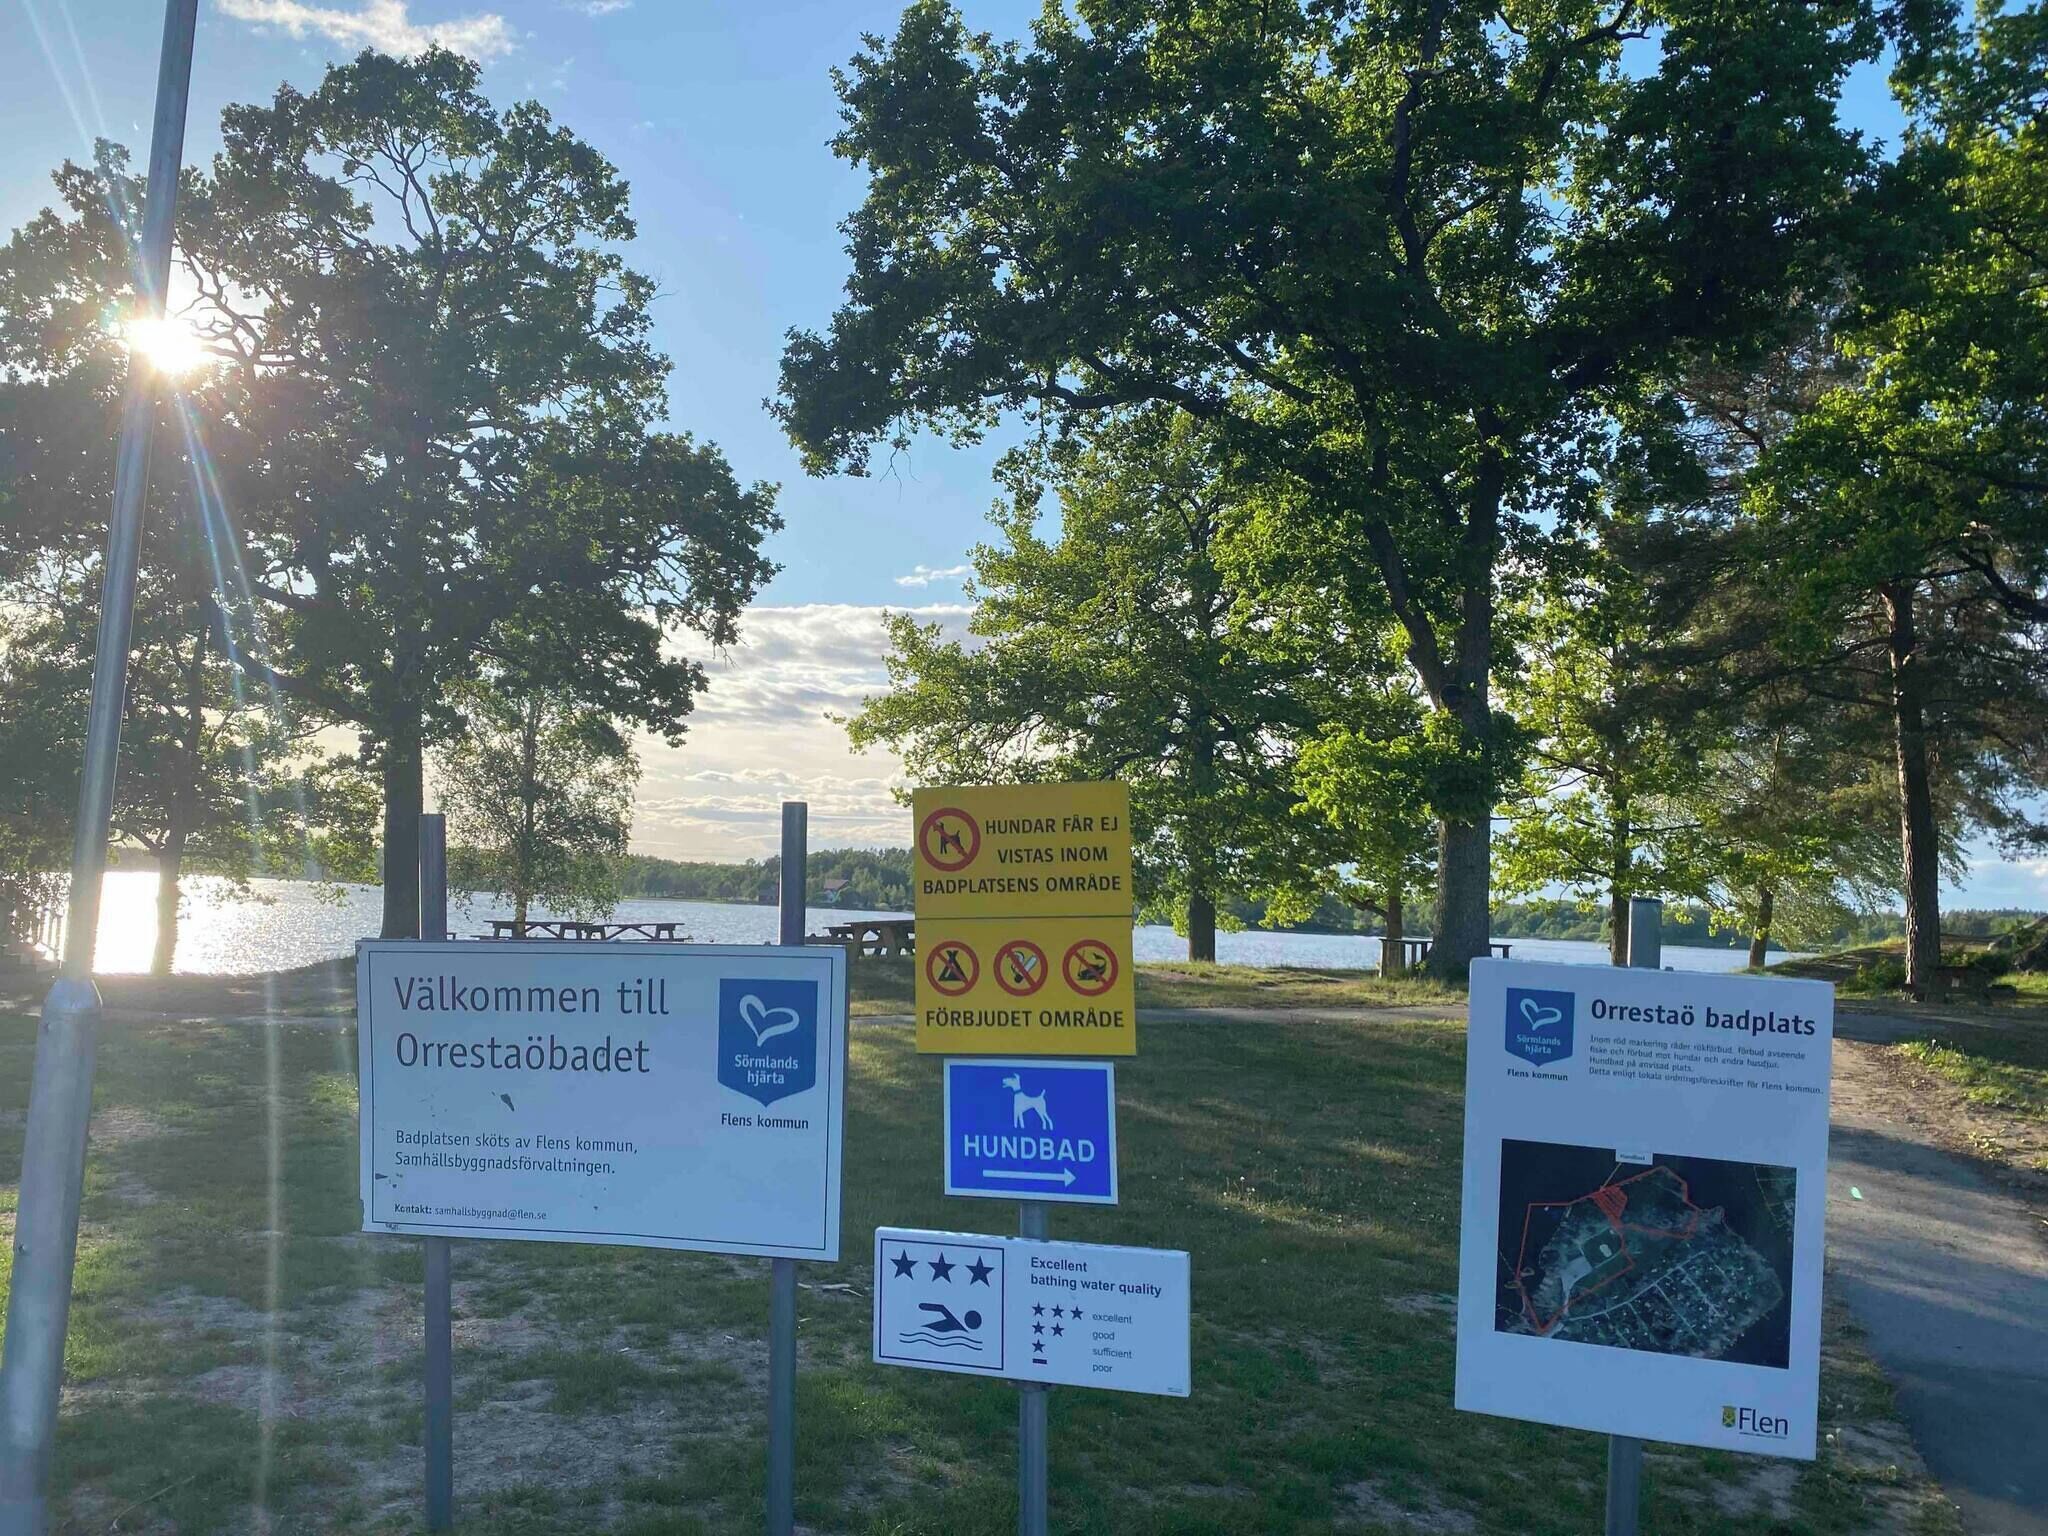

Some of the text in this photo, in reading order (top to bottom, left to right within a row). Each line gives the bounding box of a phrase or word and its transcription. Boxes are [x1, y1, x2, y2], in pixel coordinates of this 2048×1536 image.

[985, 814, 1119, 834] HUNDAR FÅR EJ
[998, 846, 1108, 864] VISTAS INOM
[923, 872, 1121, 895] BADPLATSENS OMRÅDE
[394, 976, 670, 1015] Välkommen till
[926, 1007, 1124, 1028] FÖRBJUDET OMRÅDE
[1591, 998, 1816, 1037] Orrestaö badplats
[1516, 1034, 1561, 1047] Sörmlands
[1590, 1034, 1611, 1044] Inom
[1629, 1039, 1668, 1050] markering
[1767, 1051, 1806, 1060] avseende
[396, 1033, 650, 1073] Orrestaöbadet
[1525, 1044, 1552, 1055] hjärta
[1610, 1047, 1625, 1056] och
[1627, 1048, 1653, 1058] förbud
[734, 1053, 799, 1070] Sörmlands
[1589, 1056, 1624, 1067] Hundbad
[1626, 1059, 1637, 1069] på
[1639, 1060, 1669, 1071] anvisad
[747, 1070, 785, 1087] hjärta
[1507, 1068, 1569, 1081] Flens kommun
[1589, 1066, 1611, 1076] Detta
[1613, 1068, 1636, 1080] enligt
[1638, 1071, 1662, 1081] lokala
[721, 1112, 809, 1130] Flens kommun
[396, 1130, 637, 1154] Badplatsen sköts av Flens kommun,
[964, 1134, 1095, 1163] HUNDBAD
[395, 1151, 615, 1177] Samhällsbyggnadsförvaltningen.
[394, 1203, 432, 1215] Kontakt:
[1031, 1257, 1087, 1273] Excellent
[1031, 1274, 1162, 1299] bathing water quality
[1092, 1313, 1132, 1325] excellent
[1092, 1331, 1115, 1341] good
[1092, 1347, 1132, 1360] sufficient
[1092, 1363, 1113, 1374] poor
[1739, 1407, 1789, 1436] Flen
